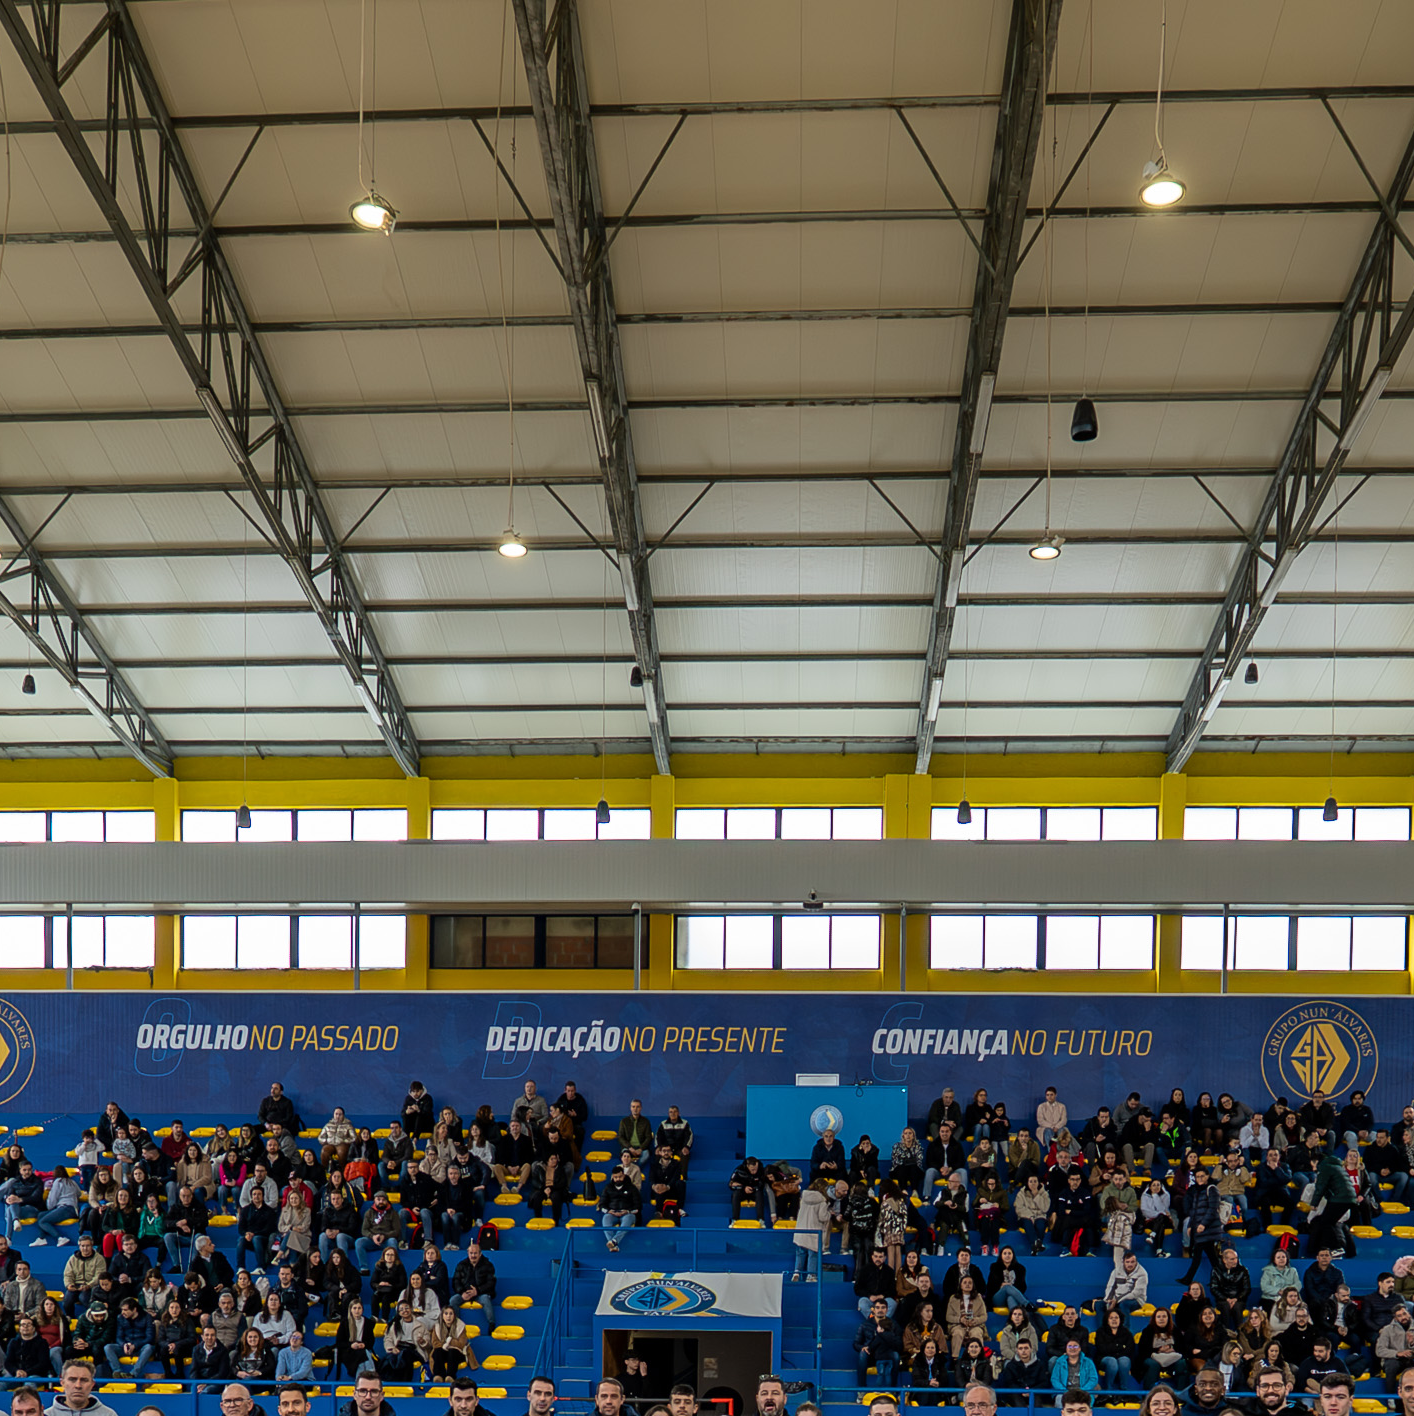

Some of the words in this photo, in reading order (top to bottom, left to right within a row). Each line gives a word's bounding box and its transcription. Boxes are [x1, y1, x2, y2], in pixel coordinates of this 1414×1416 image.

[137, 1023, 249, 1050] ORGULHO
[249, 1025, 284, 1051] NO
[290, 1025, 400, 1051] PASSADO
[486, 1019, 622, 1058] DEDICAÇÃO
[621, 1026, 656, 1052] NO
[663, 1027, 787, 1053] PRESENTE
[872, 1029, 1008, 1061] CONFIANÇA
[1011, 1030, 1047, 1056] NO
[1053, 1030, 1153, 1056] FUTURO
[1268, 1016, 1298, 1057] GRUPO
